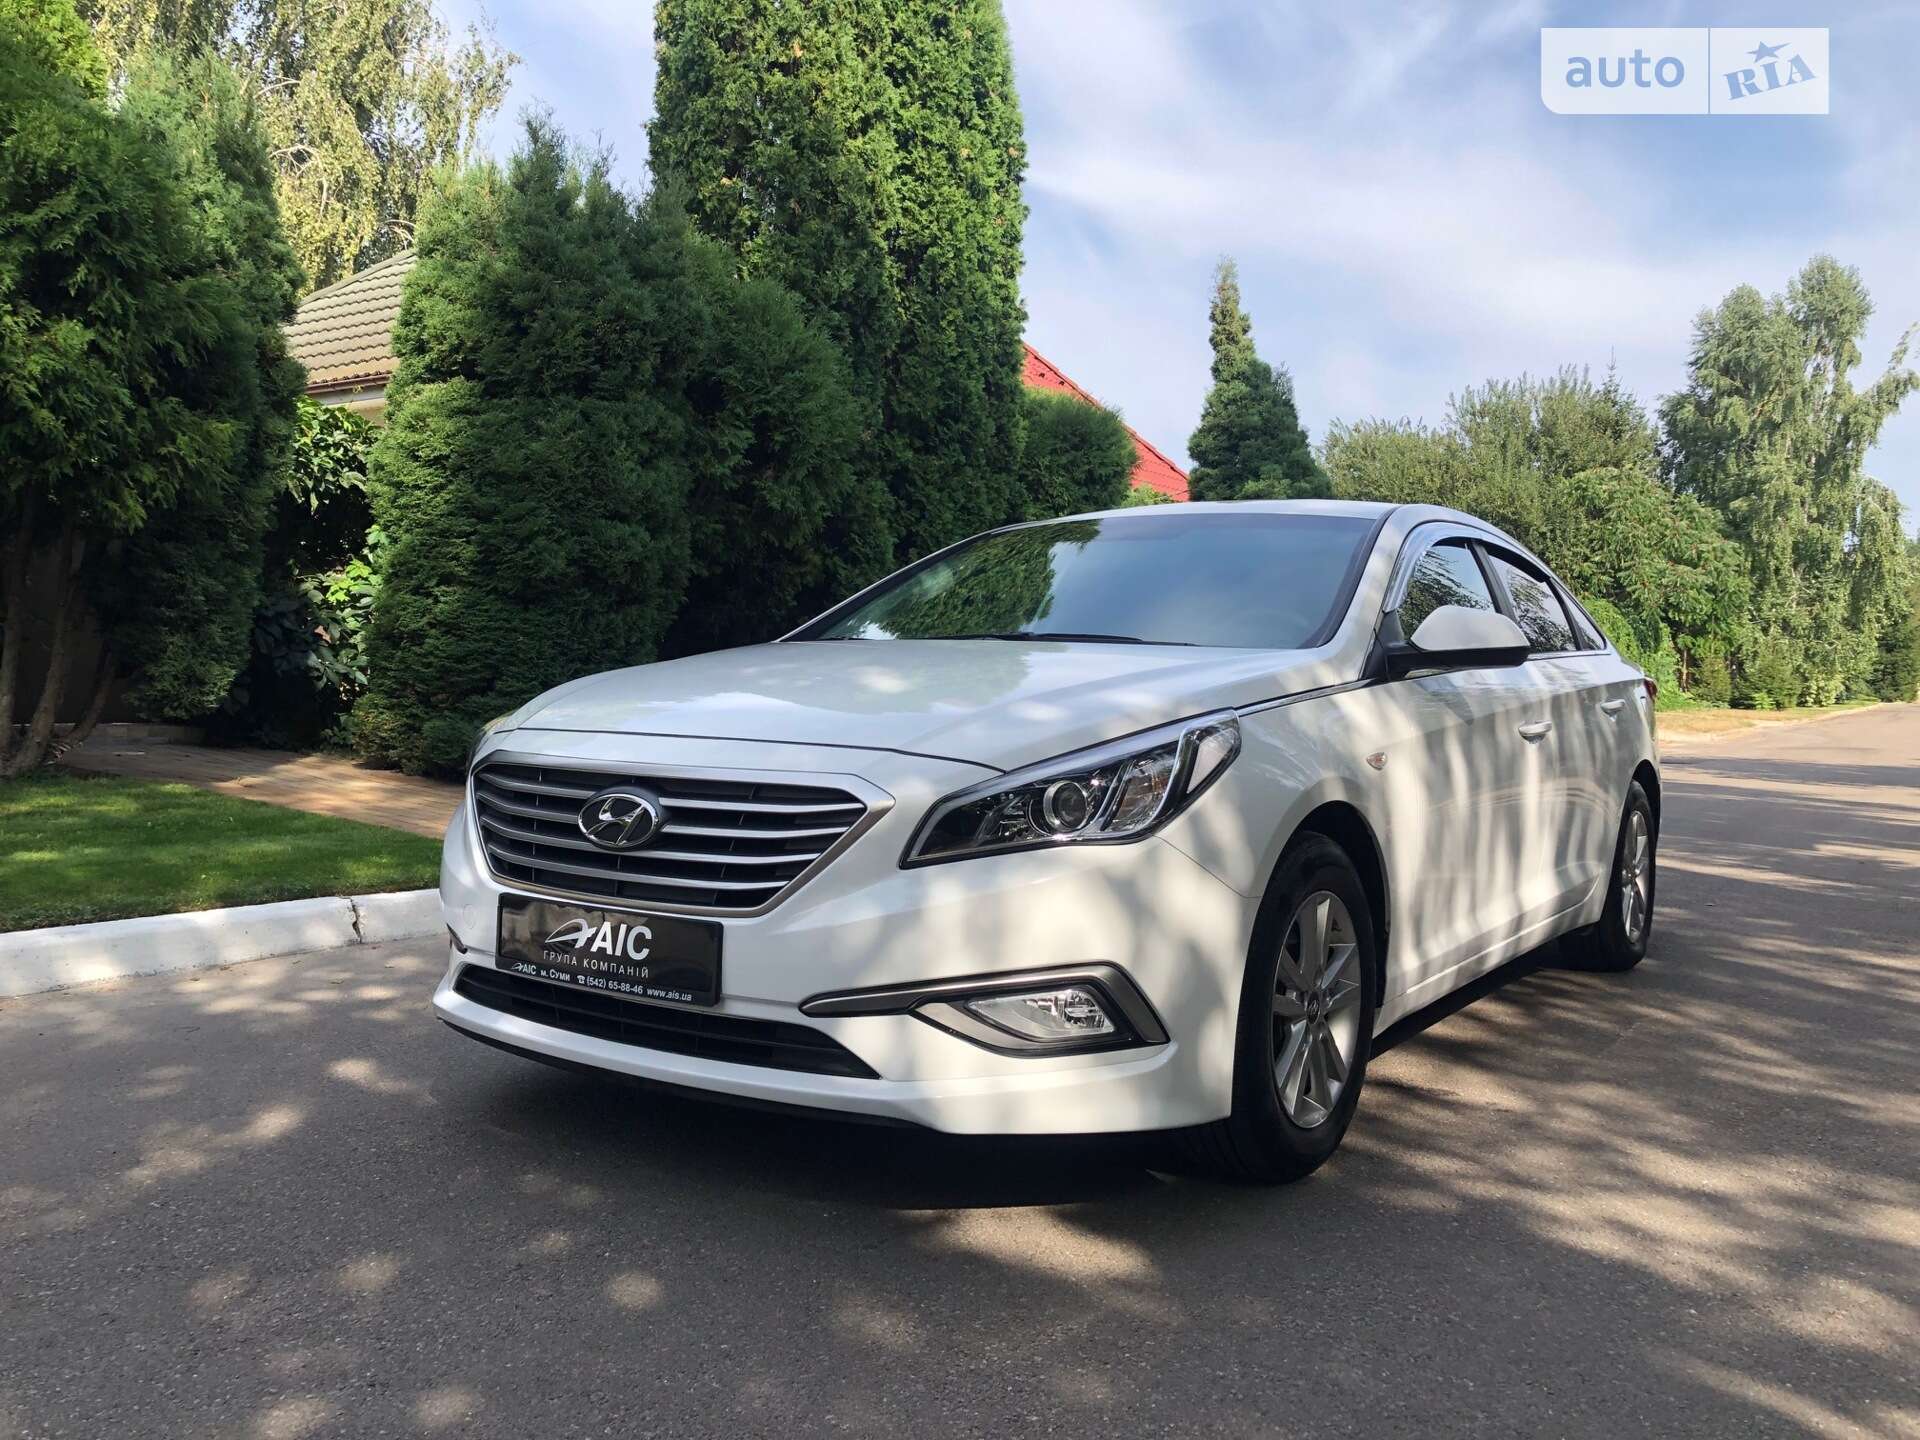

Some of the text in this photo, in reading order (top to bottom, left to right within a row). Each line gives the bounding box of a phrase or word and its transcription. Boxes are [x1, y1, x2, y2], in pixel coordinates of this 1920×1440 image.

[543, 950, 650, 979] ГРУПА КОМПАНІЙ
[586, 975, 606, 989] (542)
[608, 980, 644, 995] 65-88-46
[646, 988, 693, 1002] www.ais.ua
